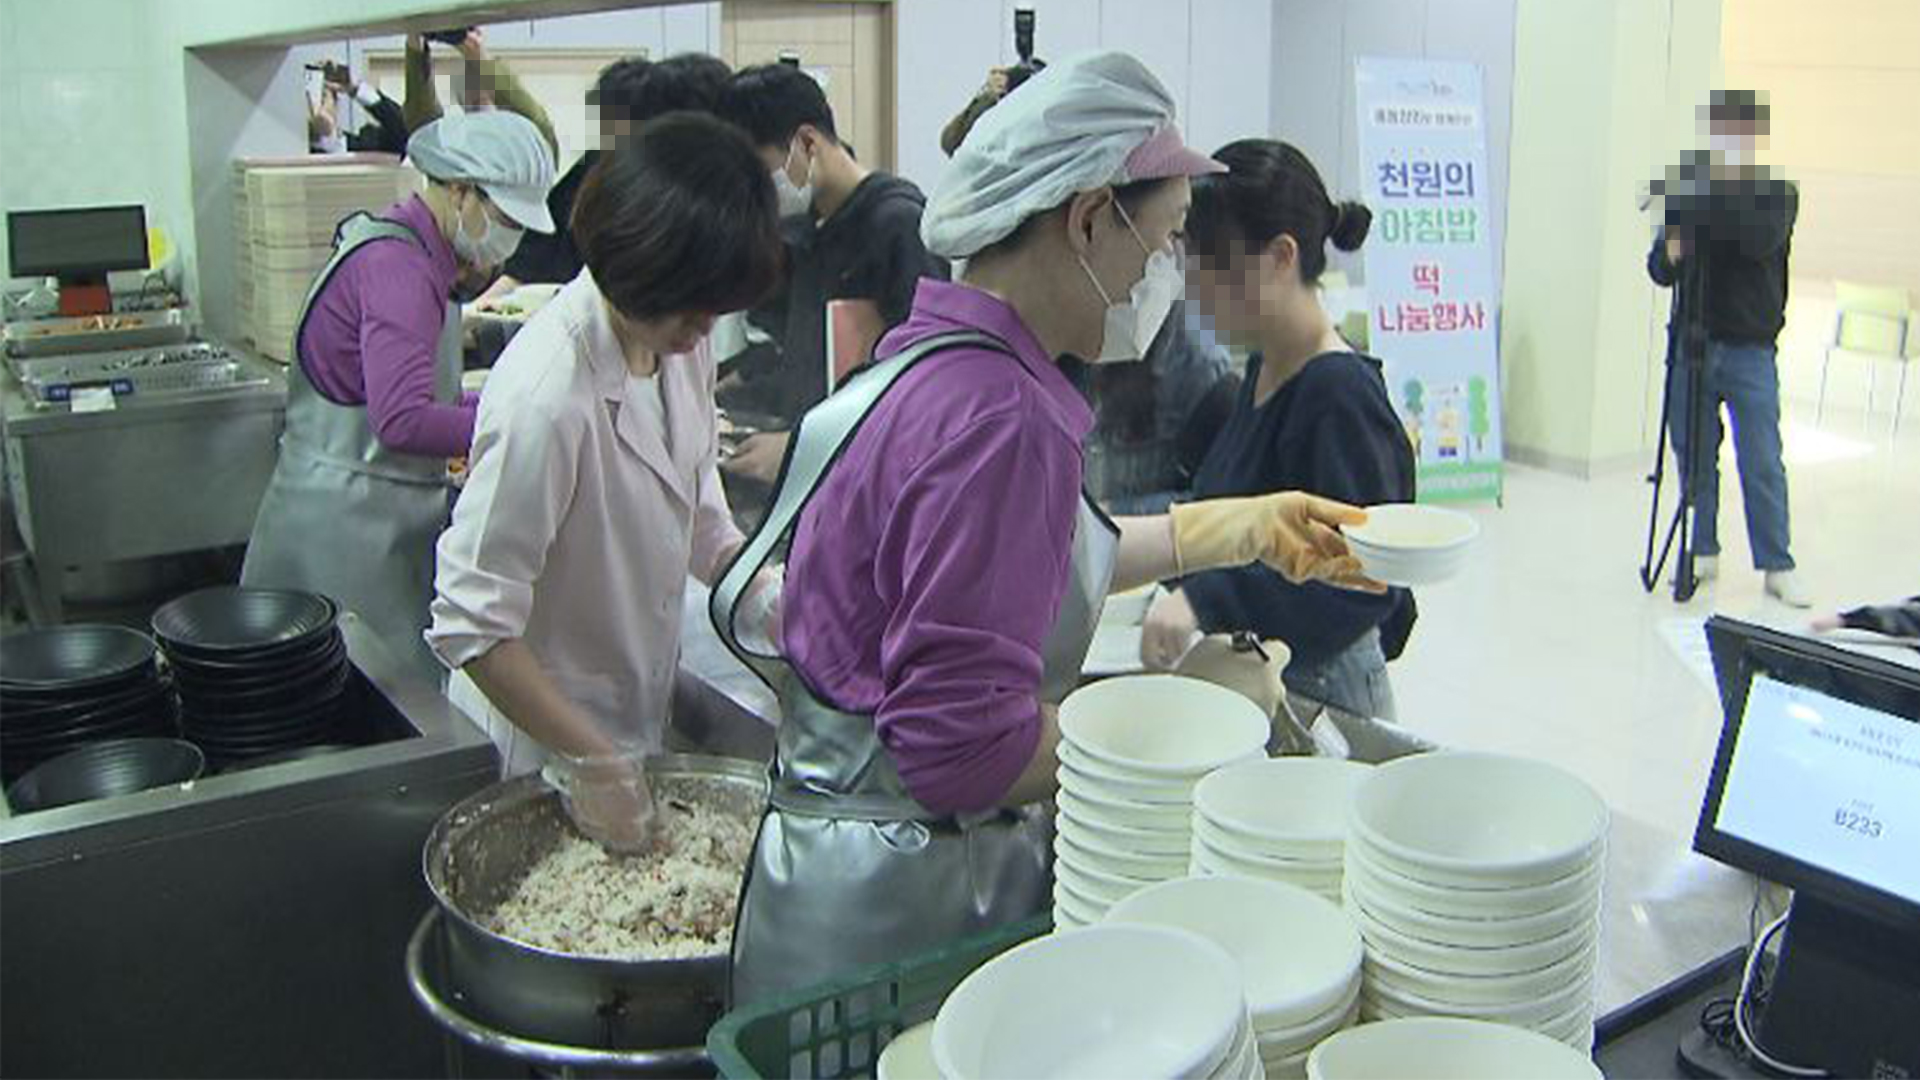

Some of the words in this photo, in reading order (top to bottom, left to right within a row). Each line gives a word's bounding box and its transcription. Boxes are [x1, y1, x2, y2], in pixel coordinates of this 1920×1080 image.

[1379, 160, 1475, 199] 천원의
[1380, 208, 1477, 245] 아침밥
[1411, 264, 1440, 296] 떡
[1378, 301, 1485, 335] 나눔행사
